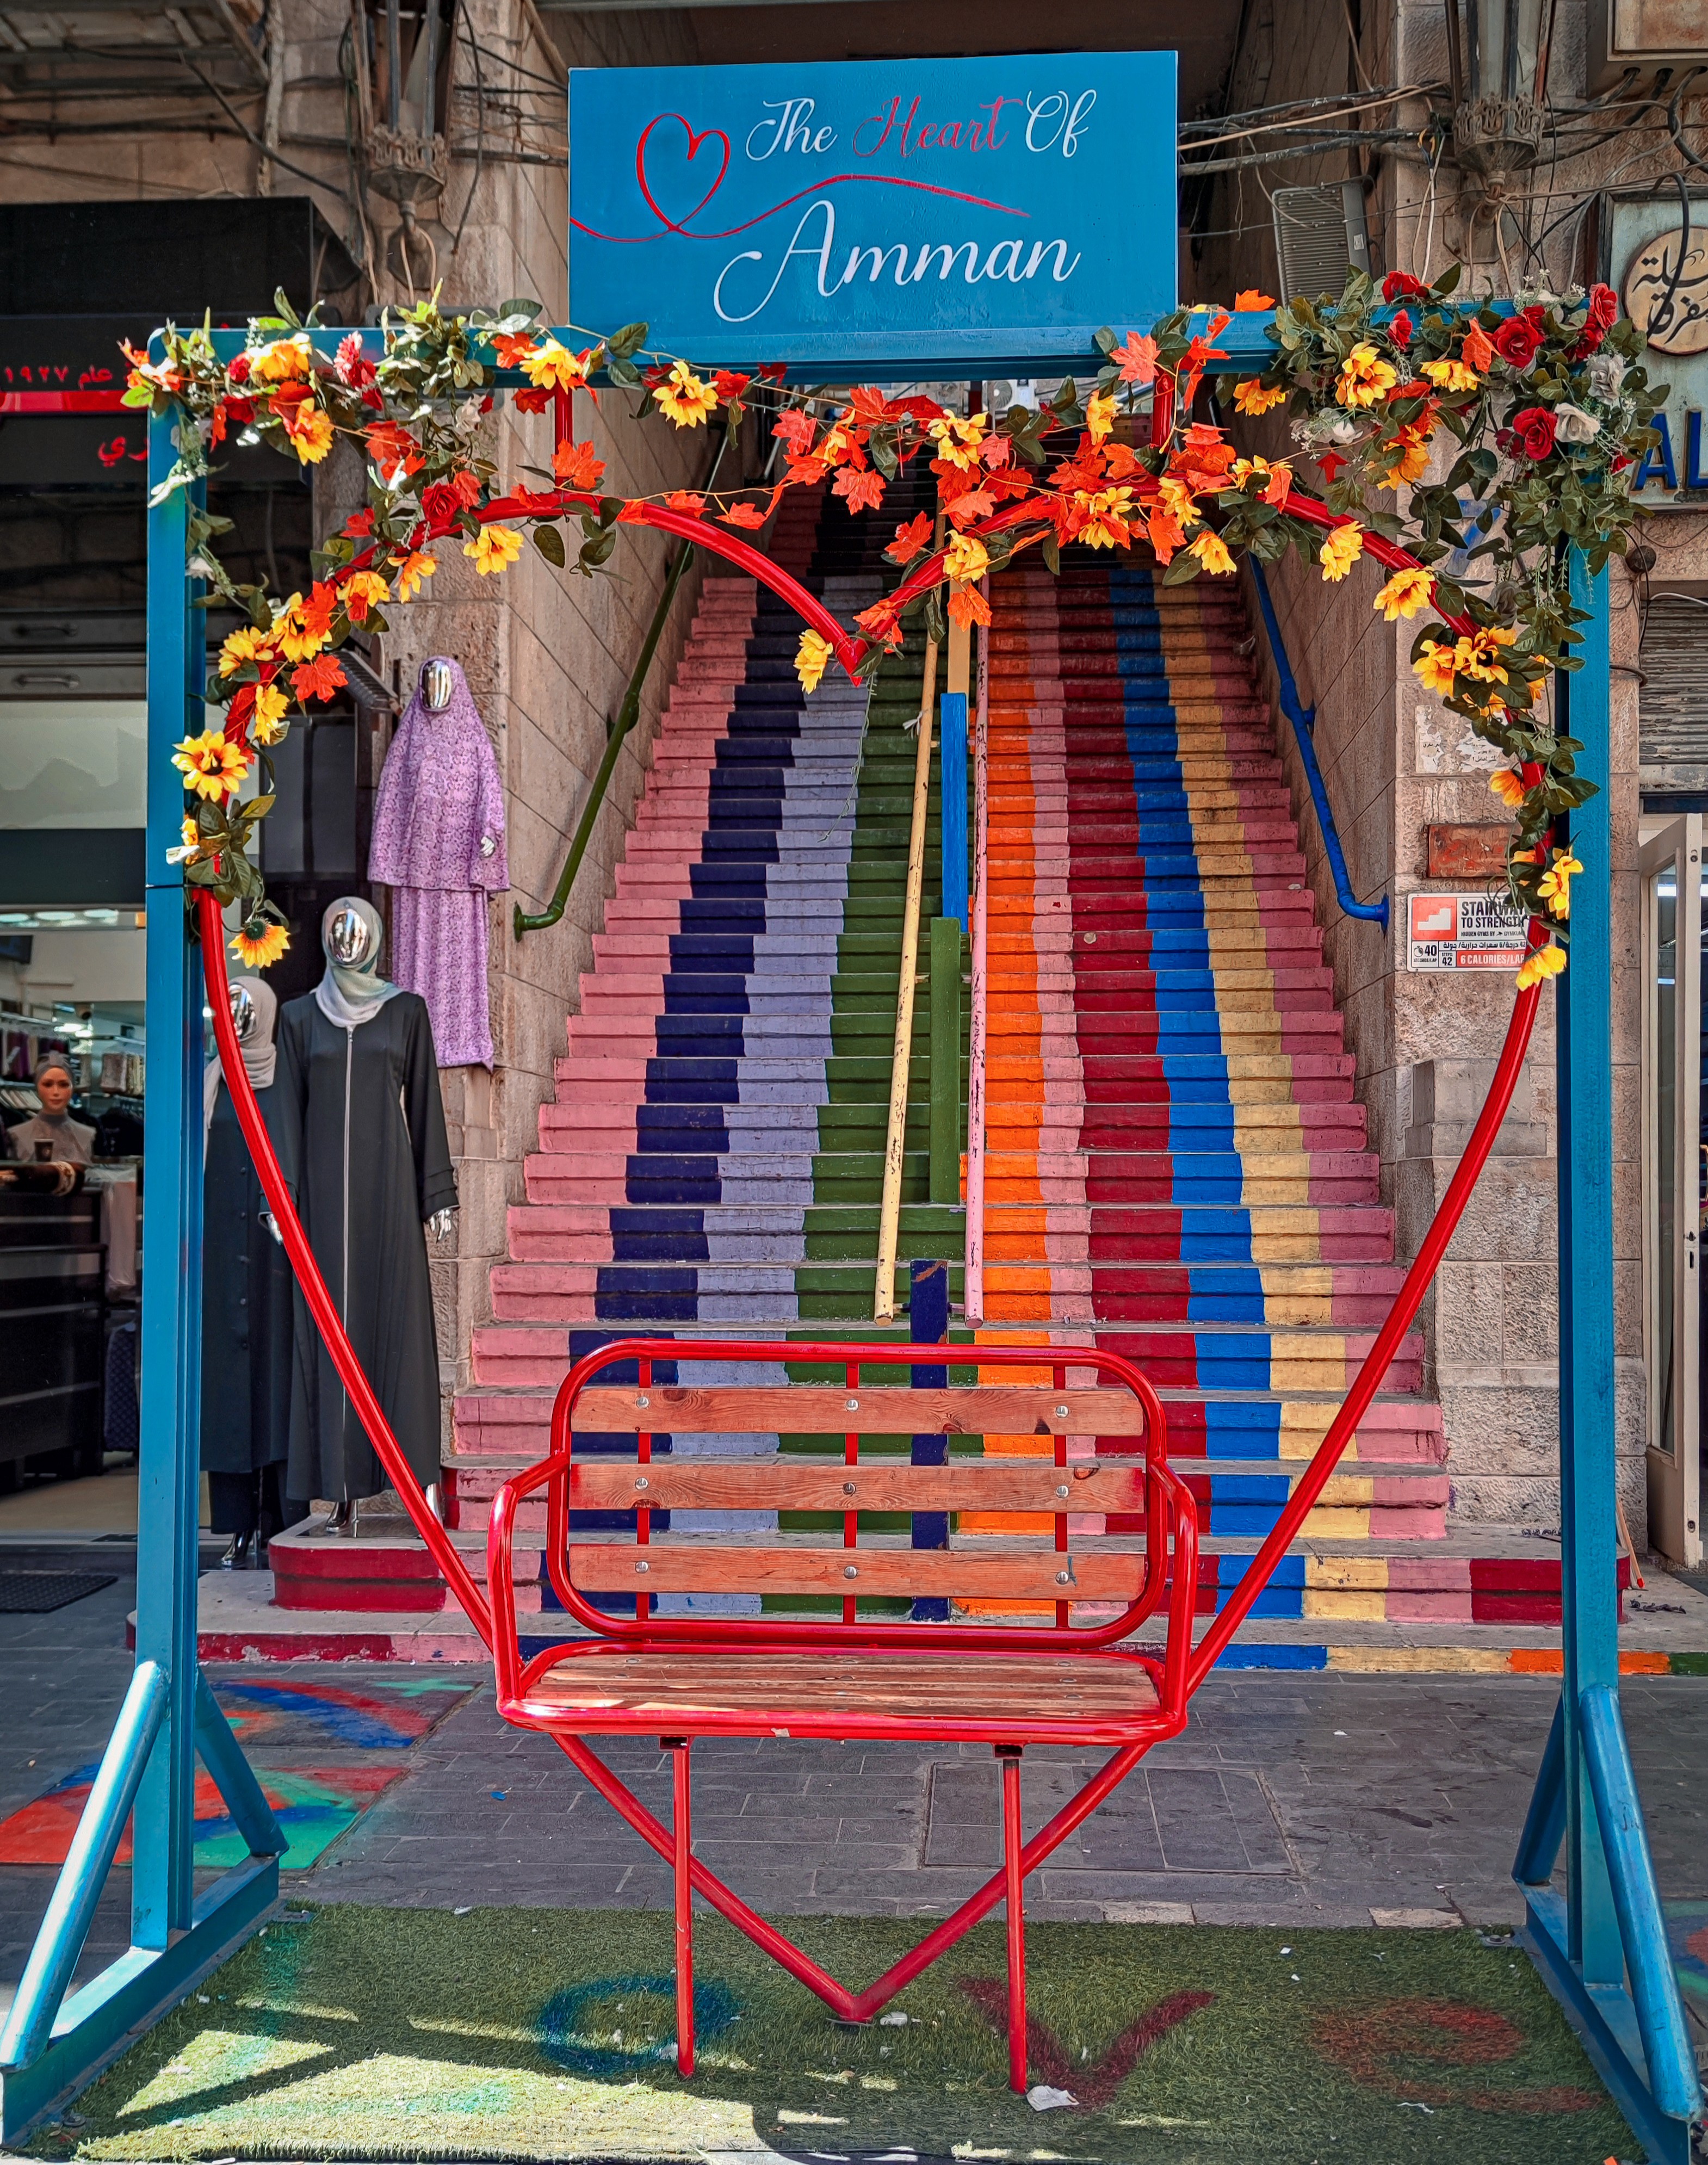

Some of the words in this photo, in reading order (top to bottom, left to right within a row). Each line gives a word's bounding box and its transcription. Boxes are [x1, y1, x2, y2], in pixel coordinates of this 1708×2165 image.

[746, 97, 838, 162] The
[852, 95, 1024, 158] Heart
[1026, 89, 1097, 158] Of
[713, 200, 1081, 323] Amman
[1461, 917, 1473, 928] TO
[1424, 945, 1437, 956] 40
[1478, 942, 1498, 950] سعرات
[1442, 957, 1452, 966] 42
[1461, 955, 1466, 964] 6
